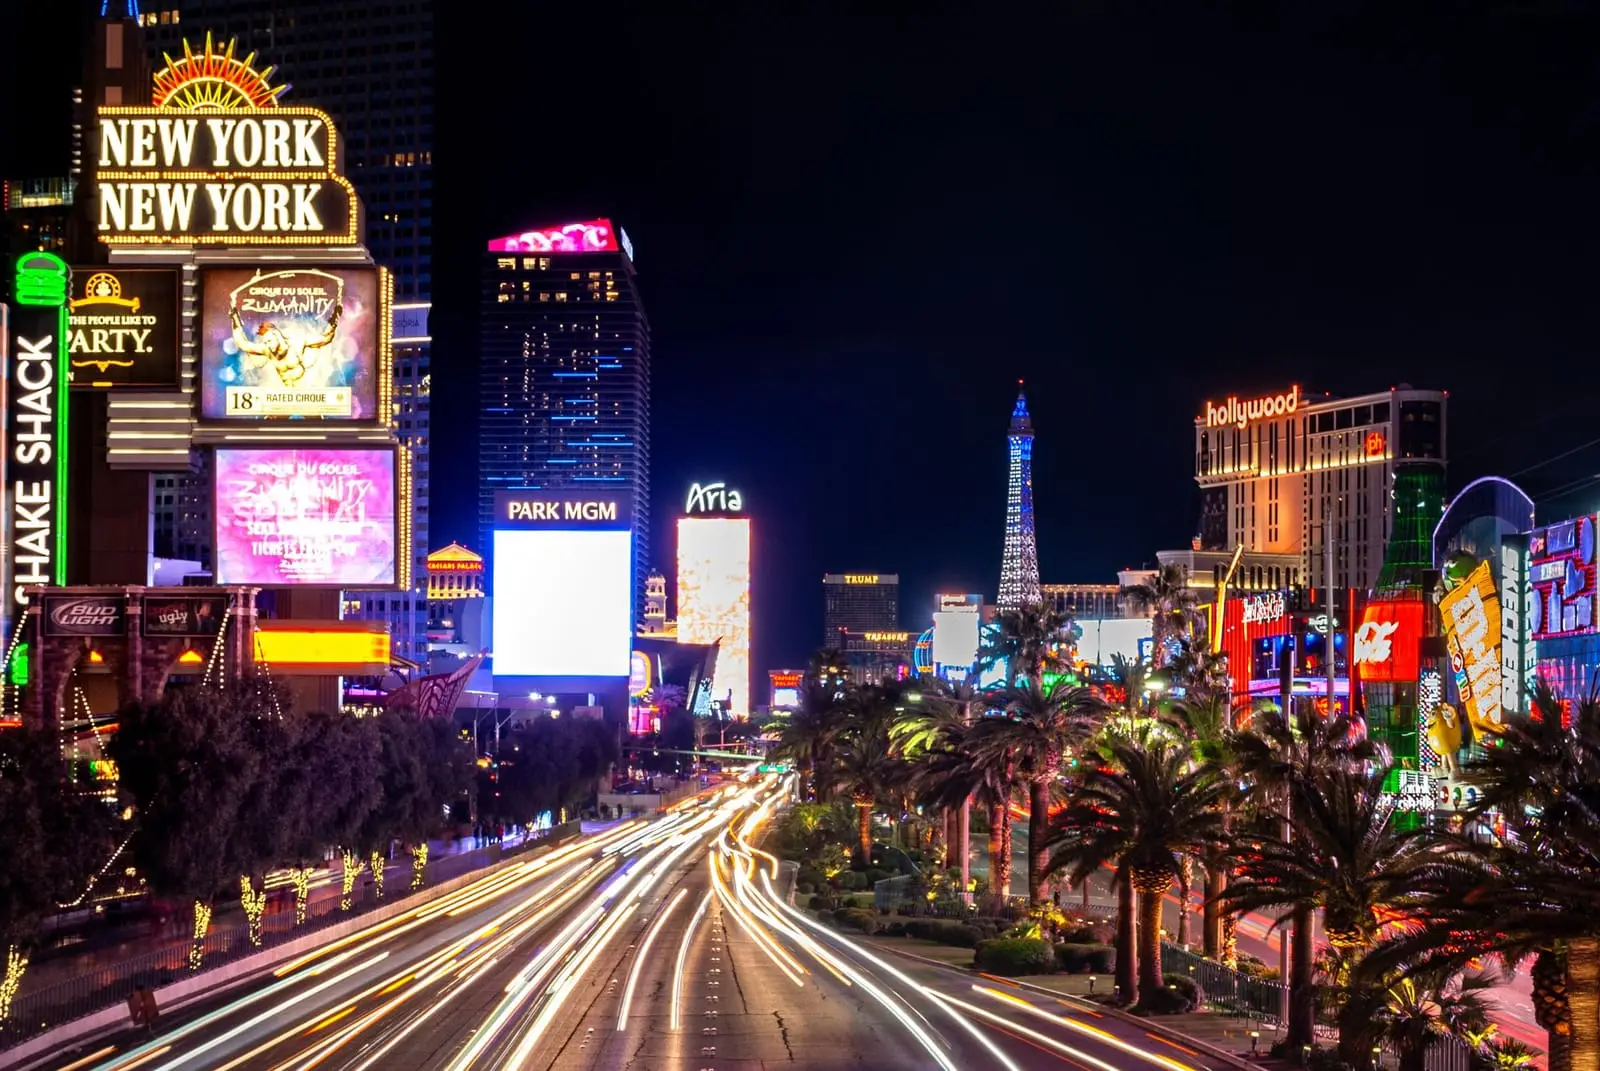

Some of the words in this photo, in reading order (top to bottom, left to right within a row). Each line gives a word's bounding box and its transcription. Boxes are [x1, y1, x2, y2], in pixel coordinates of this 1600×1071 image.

[100, 119, 197, 167] NEW
[207, 119, 324, 167] YORK
[99, 183, 197, 231] NEW
[206, 183, 323, 231] YORK
[249, 287, 281, 297] CIRQUE
[283, 287, 296, 295] DU
[297, 287, 327, 295] SOLEIL
[241, 295, 334, 320] ZUMANITY
[68, 316, 86, 325] THE
[88, 316, 121, 325] PEOPLE
[122, 316, 142, 325] LIKE
[143, 316, 157, 325] TO
[16, 334, 53, 465] SHACK
[266, 393, 293, 402] RATED
[295, 393, 326, 403] CIRQUE
[1206, 385, 1298, 429] hollywood
[685, 483, 743, 513] Aria
[508, 501, 560, 520] PARK
[564, 501, 617, 521] MGM
[844, 574, 879, 585] TRUMP
[69, 605, 117, 616] BUD
[158, 609, 188, 624] ugly
[59, 615, 120, 625] LIGHT
[1501, 545, 1520, 712] SKECHERS
[864, 632, 908, 641] TREASURE
